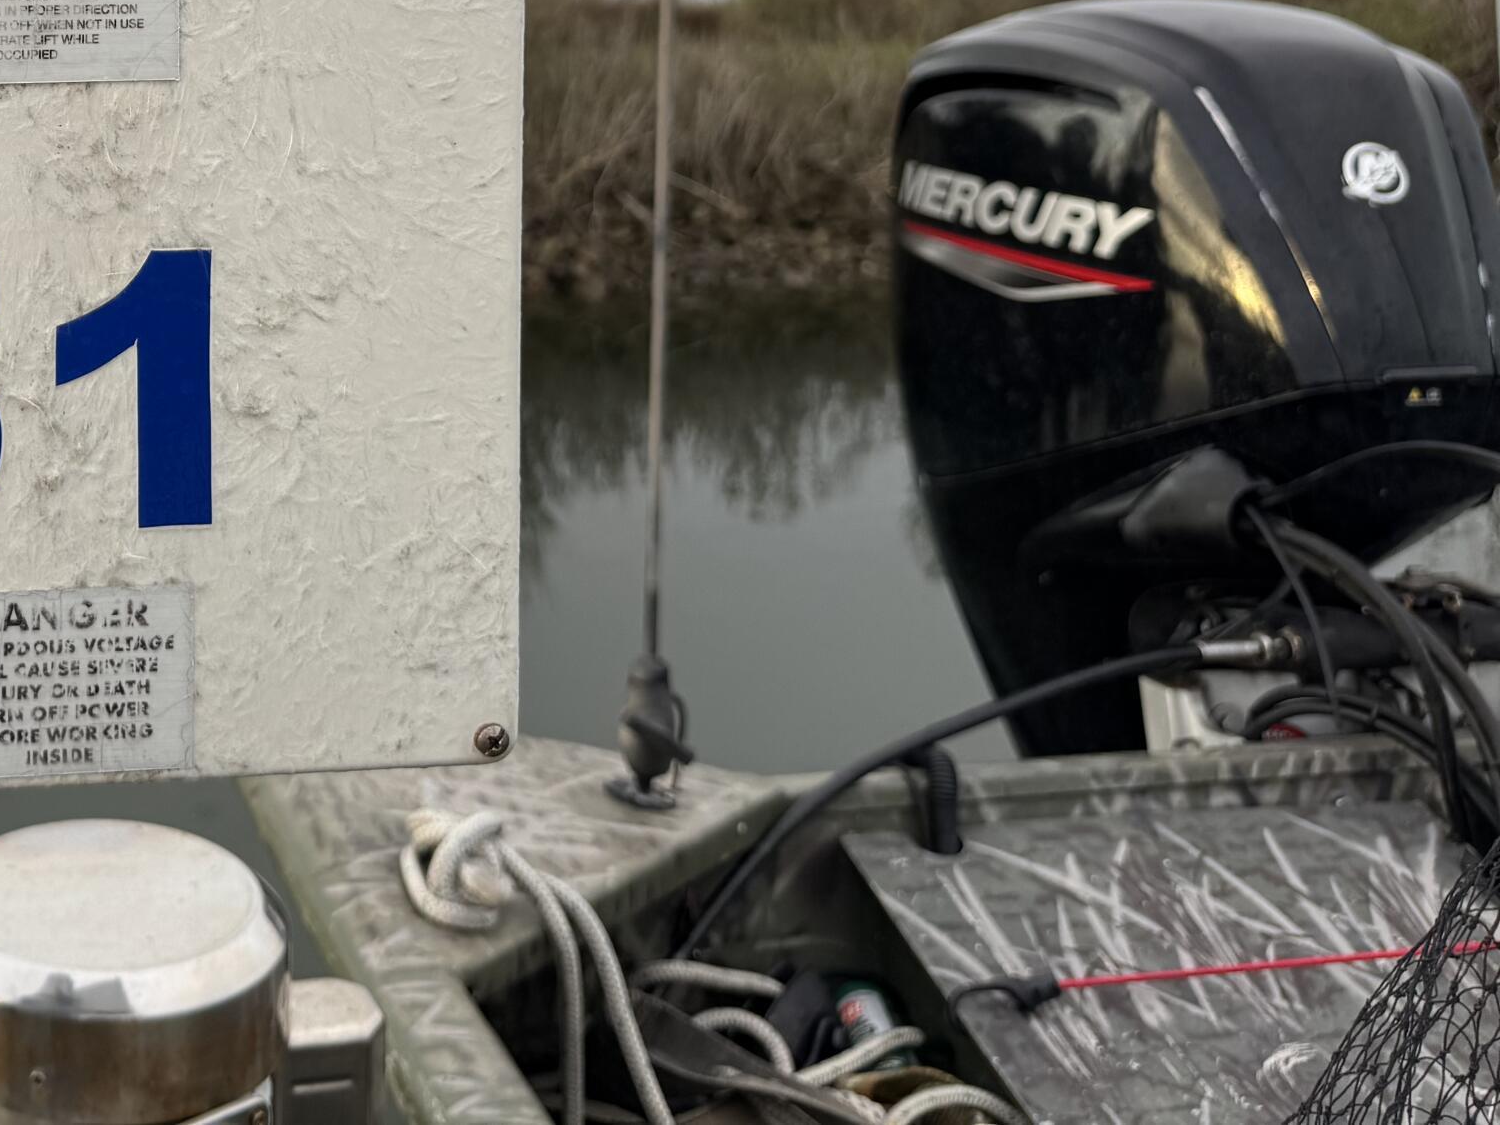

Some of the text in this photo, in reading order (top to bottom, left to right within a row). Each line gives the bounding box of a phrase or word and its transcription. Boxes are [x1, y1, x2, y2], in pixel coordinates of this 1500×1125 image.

[73, 4, 138, 15] DIRECTION
[77, 19, 102, 30] NOT
[105, 18, 117, 29] IN
[120, 18, 145, 29] USE
[61, 33, 99, 45] WHILE
[899, 160, 1155, 260] MERCURY
[84, 634, 175, 653] VOLTAGE
[15, 660, 80, 678] CAUSE
[52, 682, 80, 699] OR
[86, 678, 150, 697] DEATH
[31, 705, 68, 721] OFF
[75, 701, 150, 720] POWER
[26, 747, 94, 766] INSIDE
